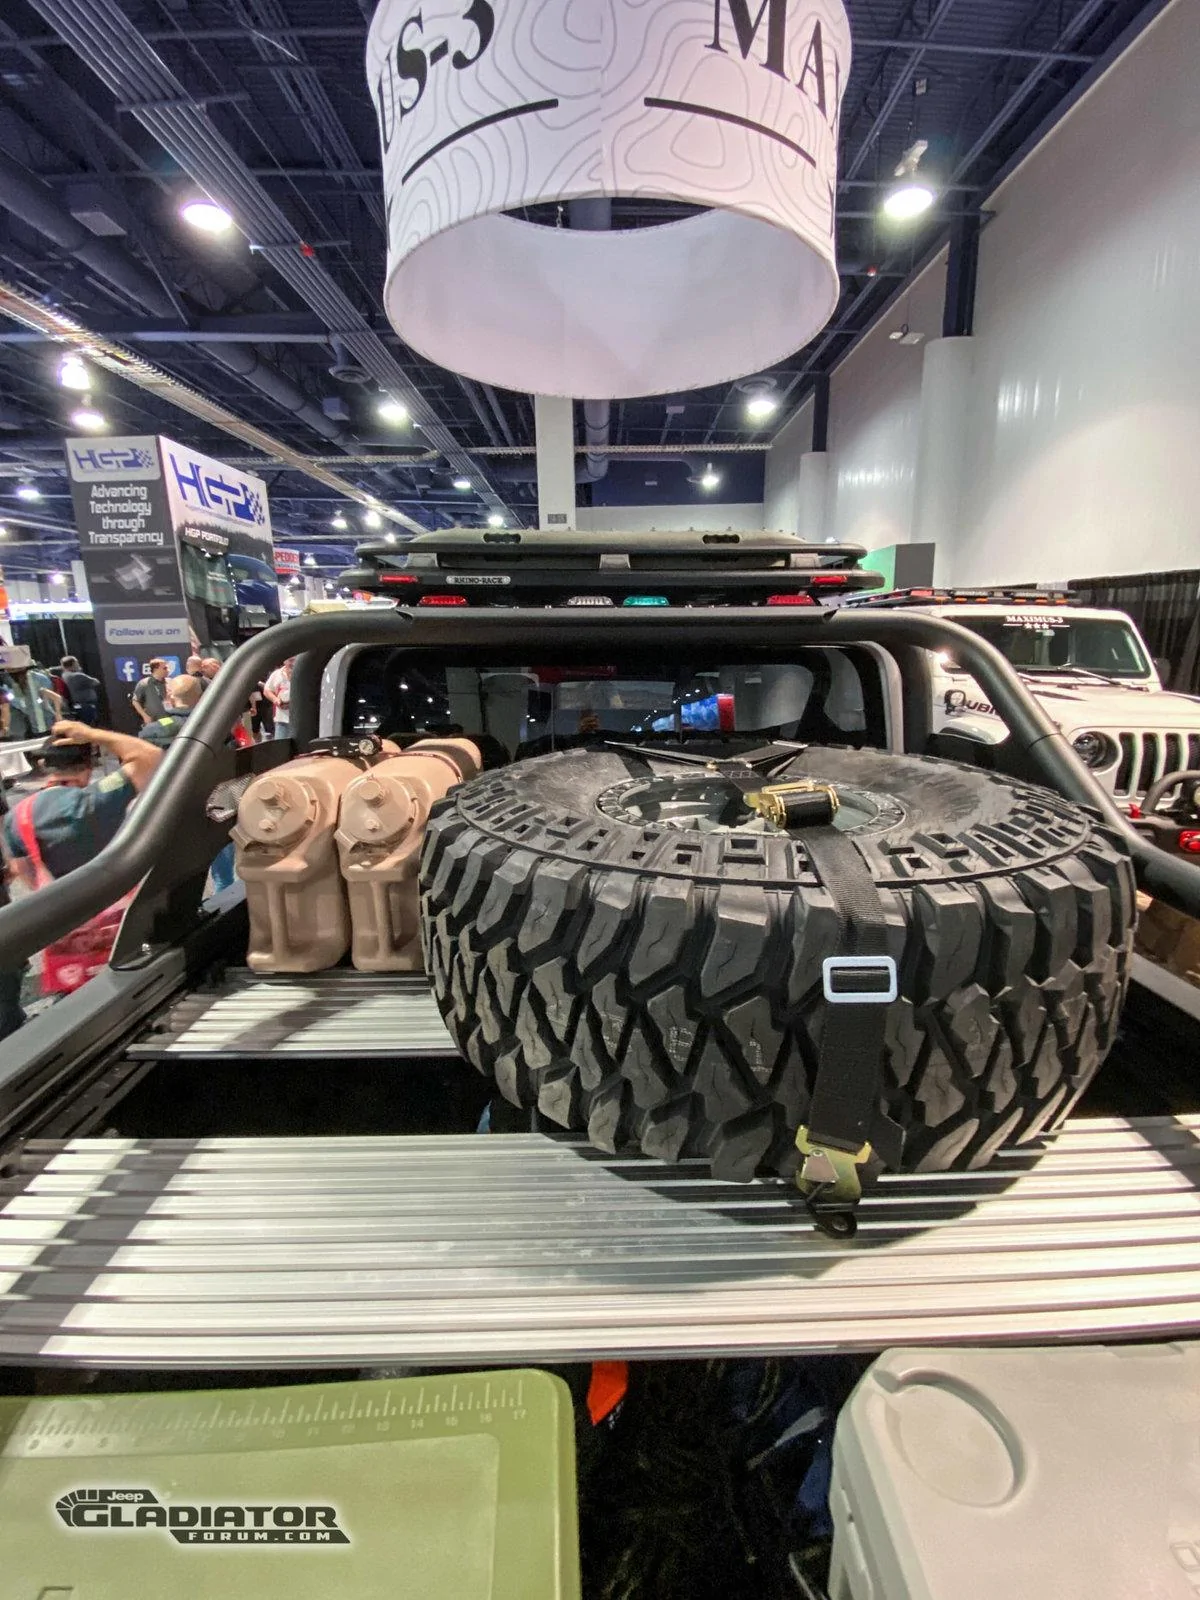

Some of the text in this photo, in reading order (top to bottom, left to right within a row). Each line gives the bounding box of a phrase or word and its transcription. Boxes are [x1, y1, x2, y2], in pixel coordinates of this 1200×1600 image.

[91, 484, 148, 500] Advancing
[169, 452, 263, 524] HGP
[89, 500, 152, 516] Technology
[102, 516, 145, 532] through
[88, 531, 164, 547] Transparency
[1006, 615, 1064, 624] MAXIMUS-3
[109, 628, 145, 637] Follow
[148, 628, 163, 636] us
